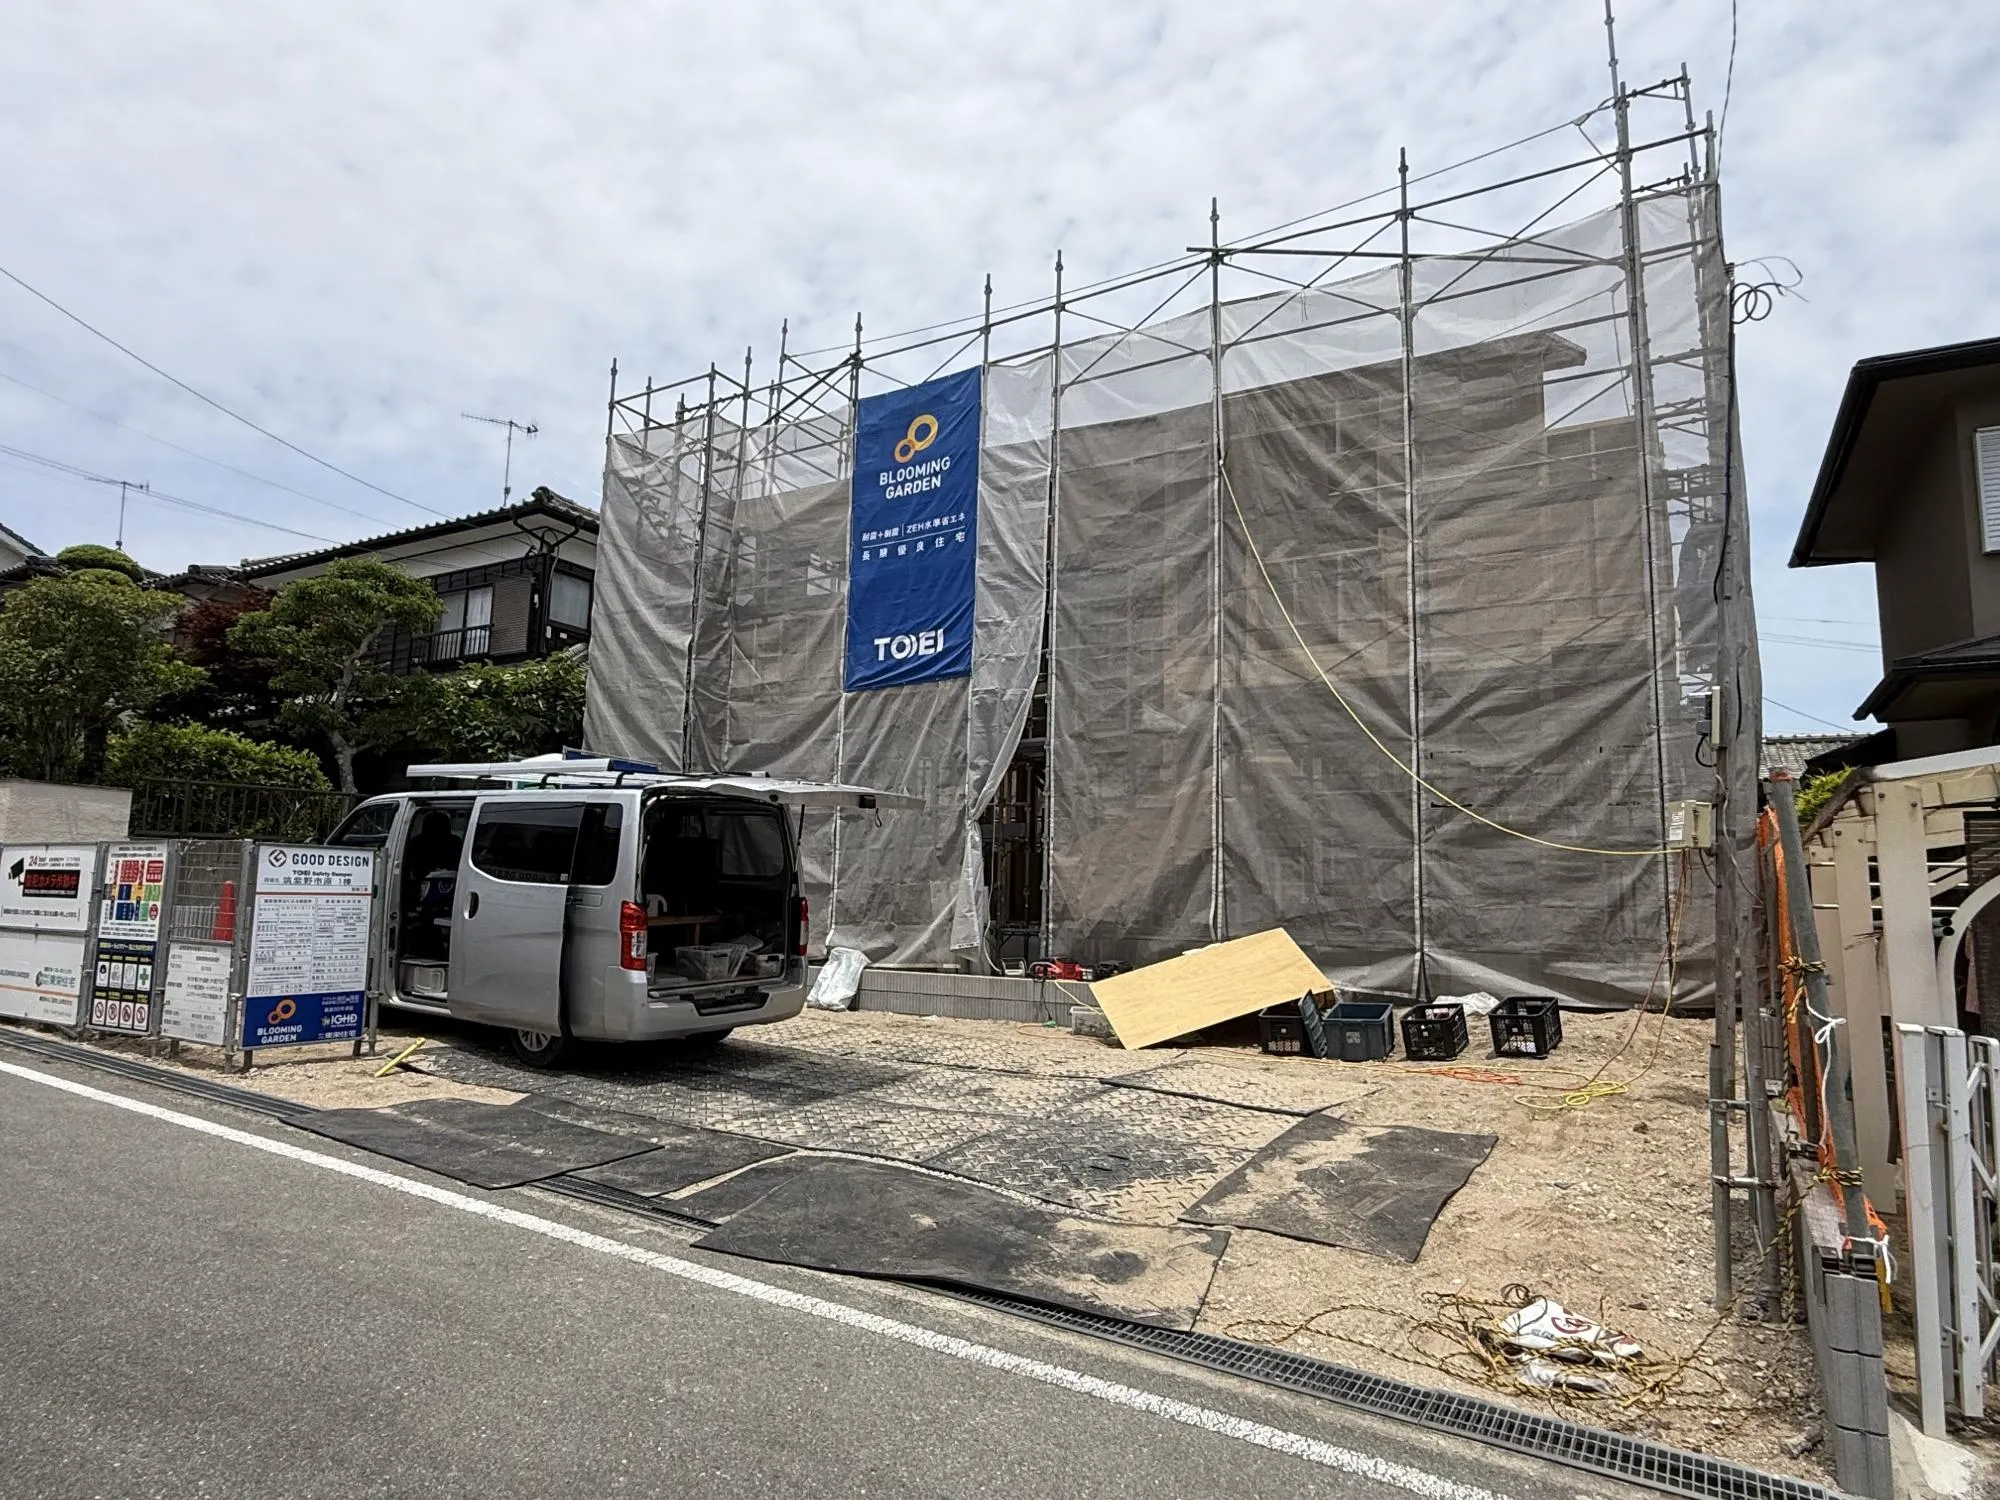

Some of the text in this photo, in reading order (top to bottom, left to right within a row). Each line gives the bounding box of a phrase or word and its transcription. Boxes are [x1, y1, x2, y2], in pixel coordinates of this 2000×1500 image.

[880, 456, 951, 486] BLOOMING
[885, 474, 942, 500] GARDEN
[873, 628, 945, 661] TOEI
[28, 855, 38, 867] 24
[292, 853, 370, 868] GOOD DESIGN
[257, 1024, 303, 1036] BLOOMING
[261, 1034, 297, 1044] GARDEN
